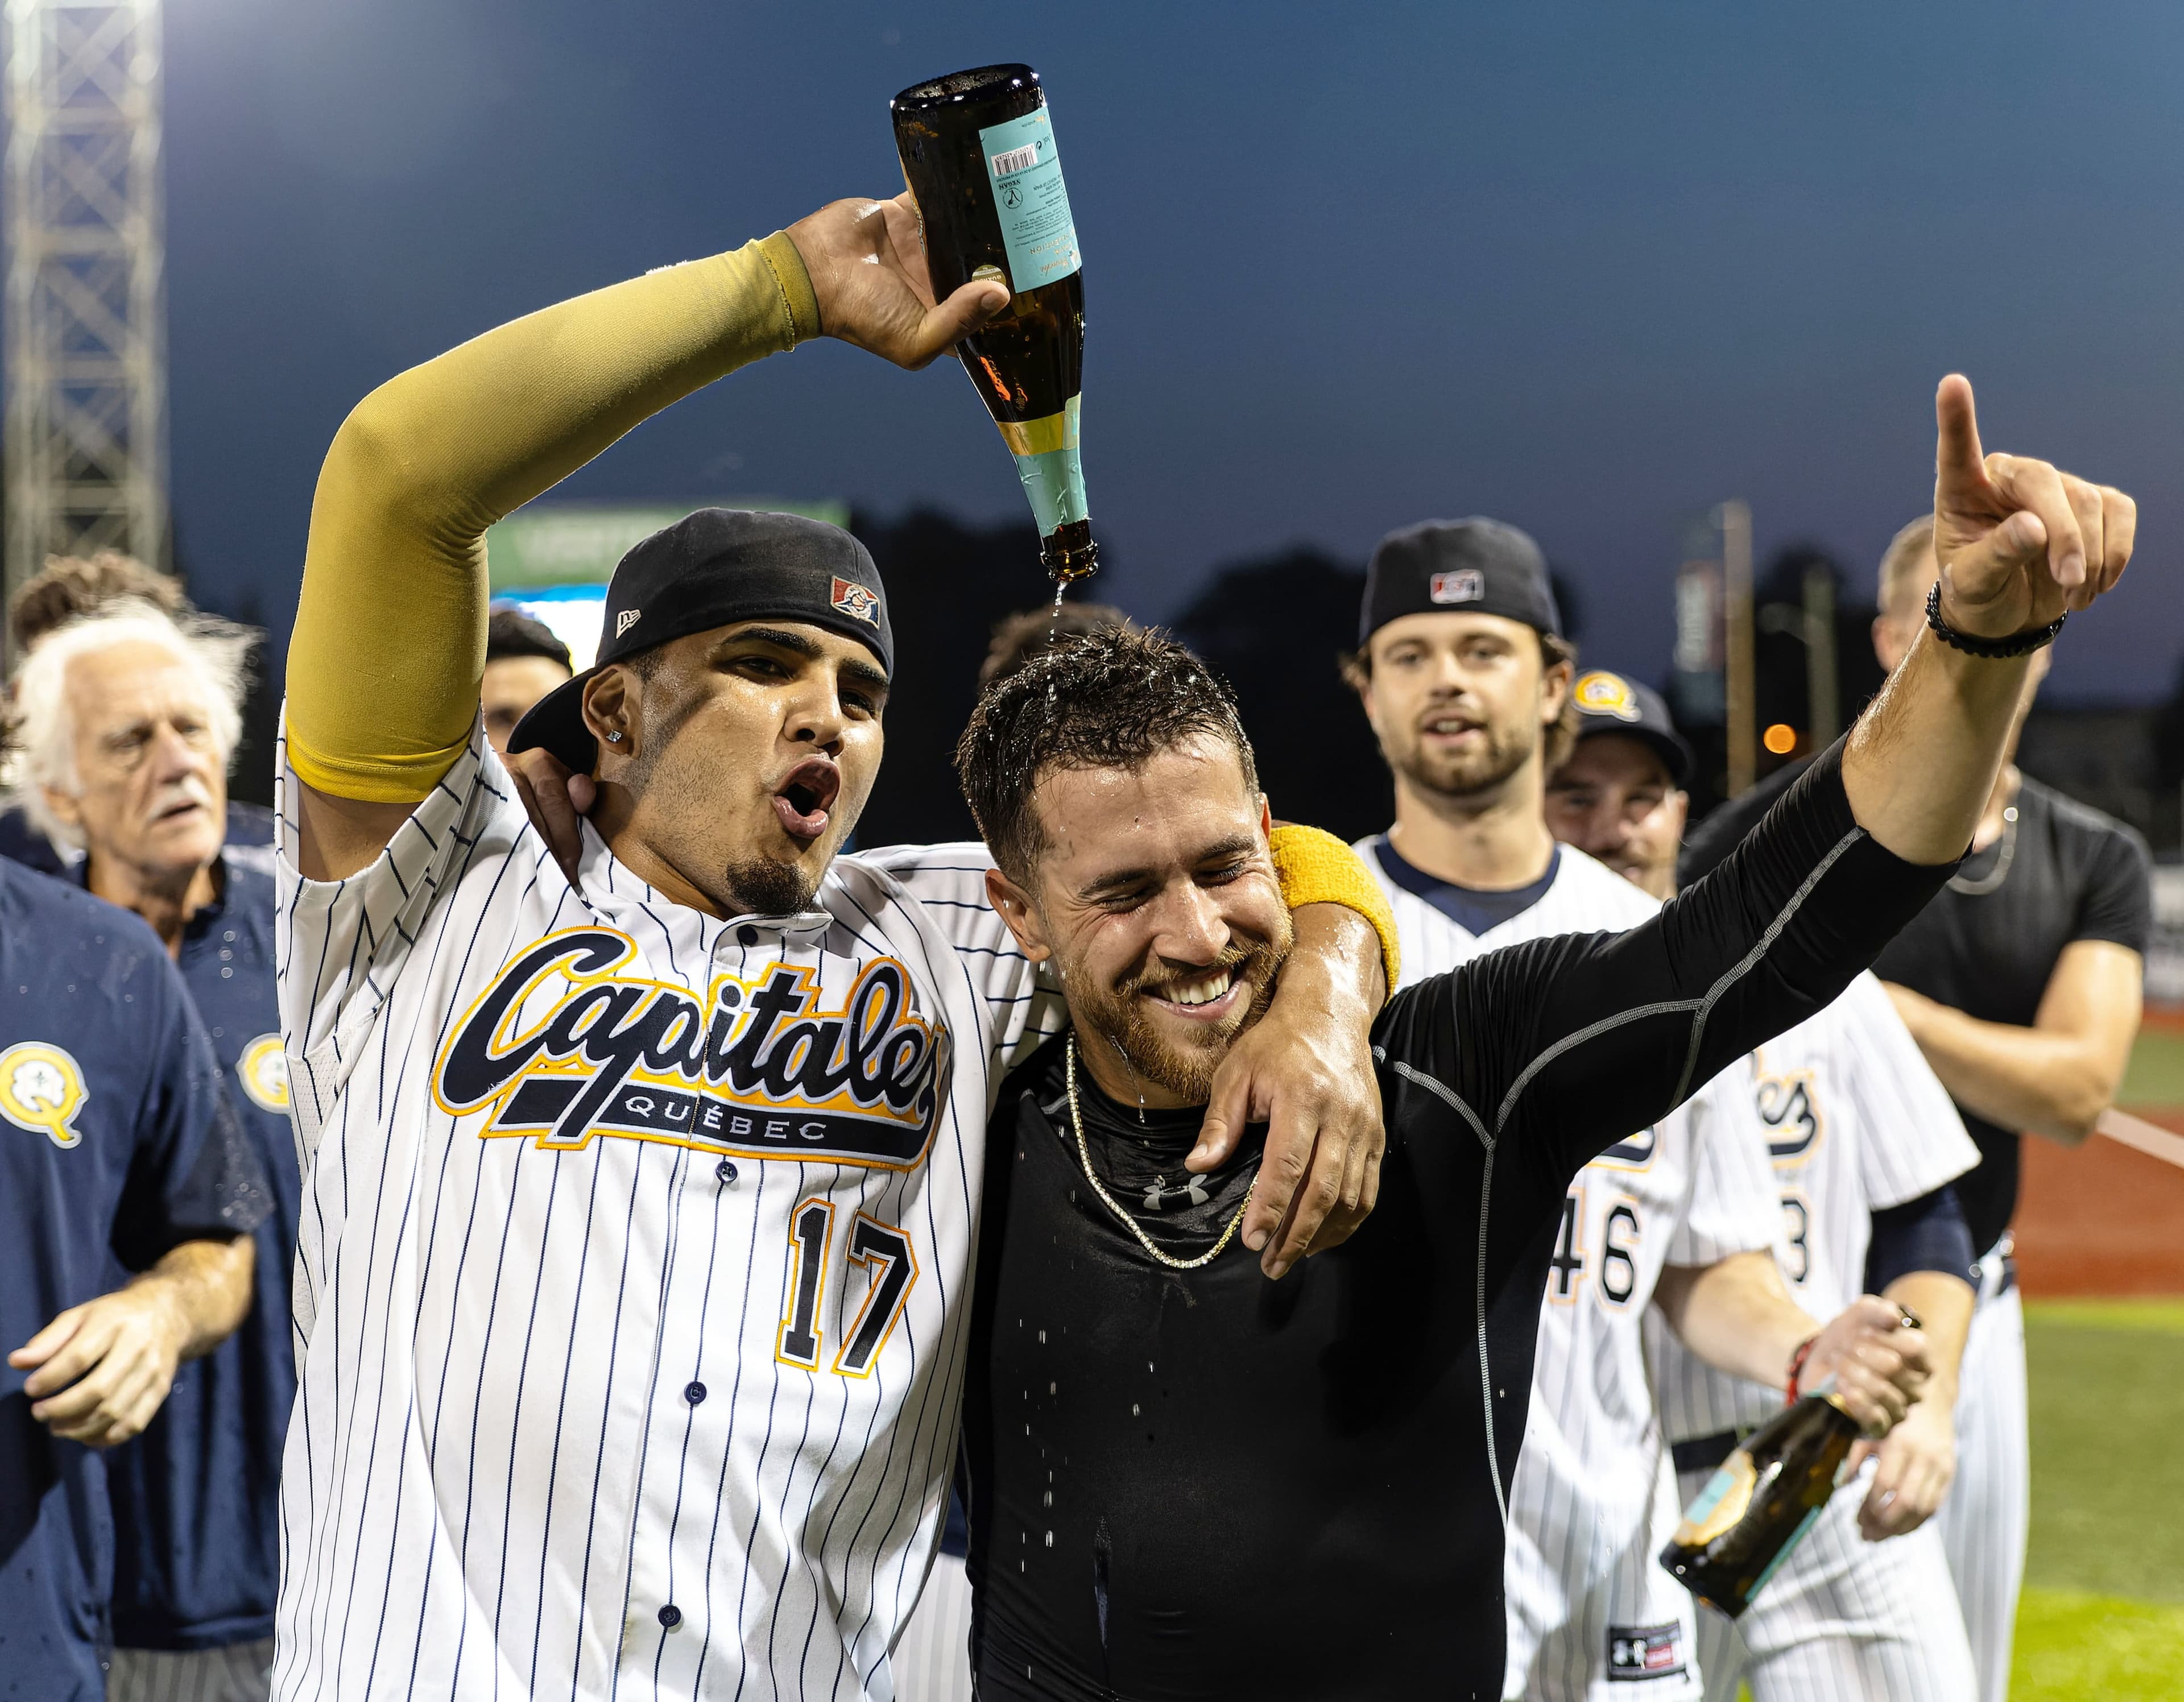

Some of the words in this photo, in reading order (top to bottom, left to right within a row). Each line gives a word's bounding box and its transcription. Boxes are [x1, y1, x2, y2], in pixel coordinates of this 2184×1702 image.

[998, 179, 1020, 190] VEGAN
[436, 928, 950, 1145] Capitales
[622, 1093, 827, 1141] QUÉBEC
[777, 1199, 918, 1377] 17
